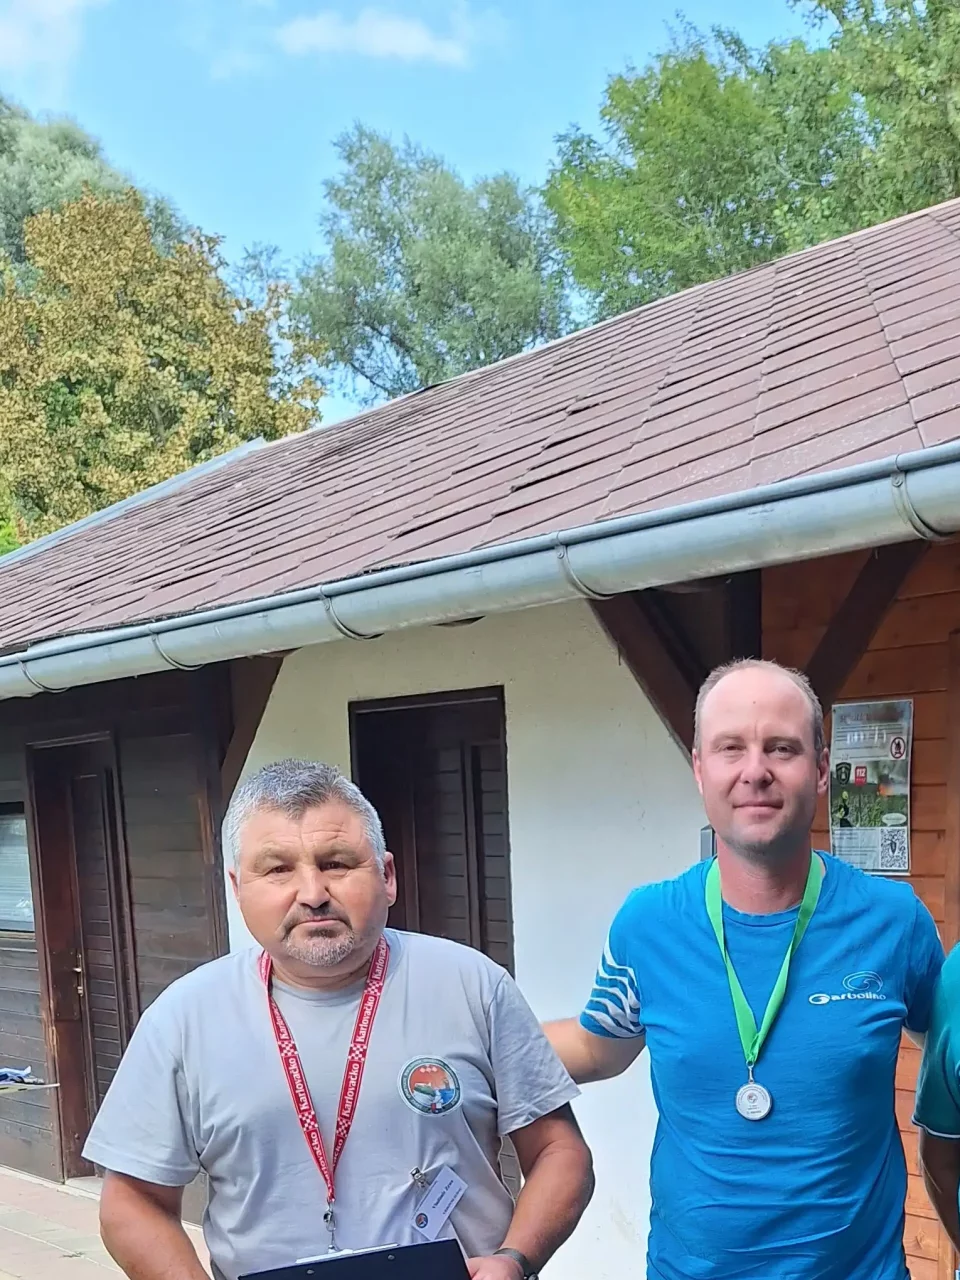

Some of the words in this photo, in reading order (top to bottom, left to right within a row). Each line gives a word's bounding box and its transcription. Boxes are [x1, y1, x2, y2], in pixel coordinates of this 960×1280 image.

[354, 996, 376, 1043] Karlovačko
[808, 991, 887, 1005] Garbolino
[288, 1057, 310, 1112] Karlovačko
[341, 1063, 360, 1118] Karlovačko
